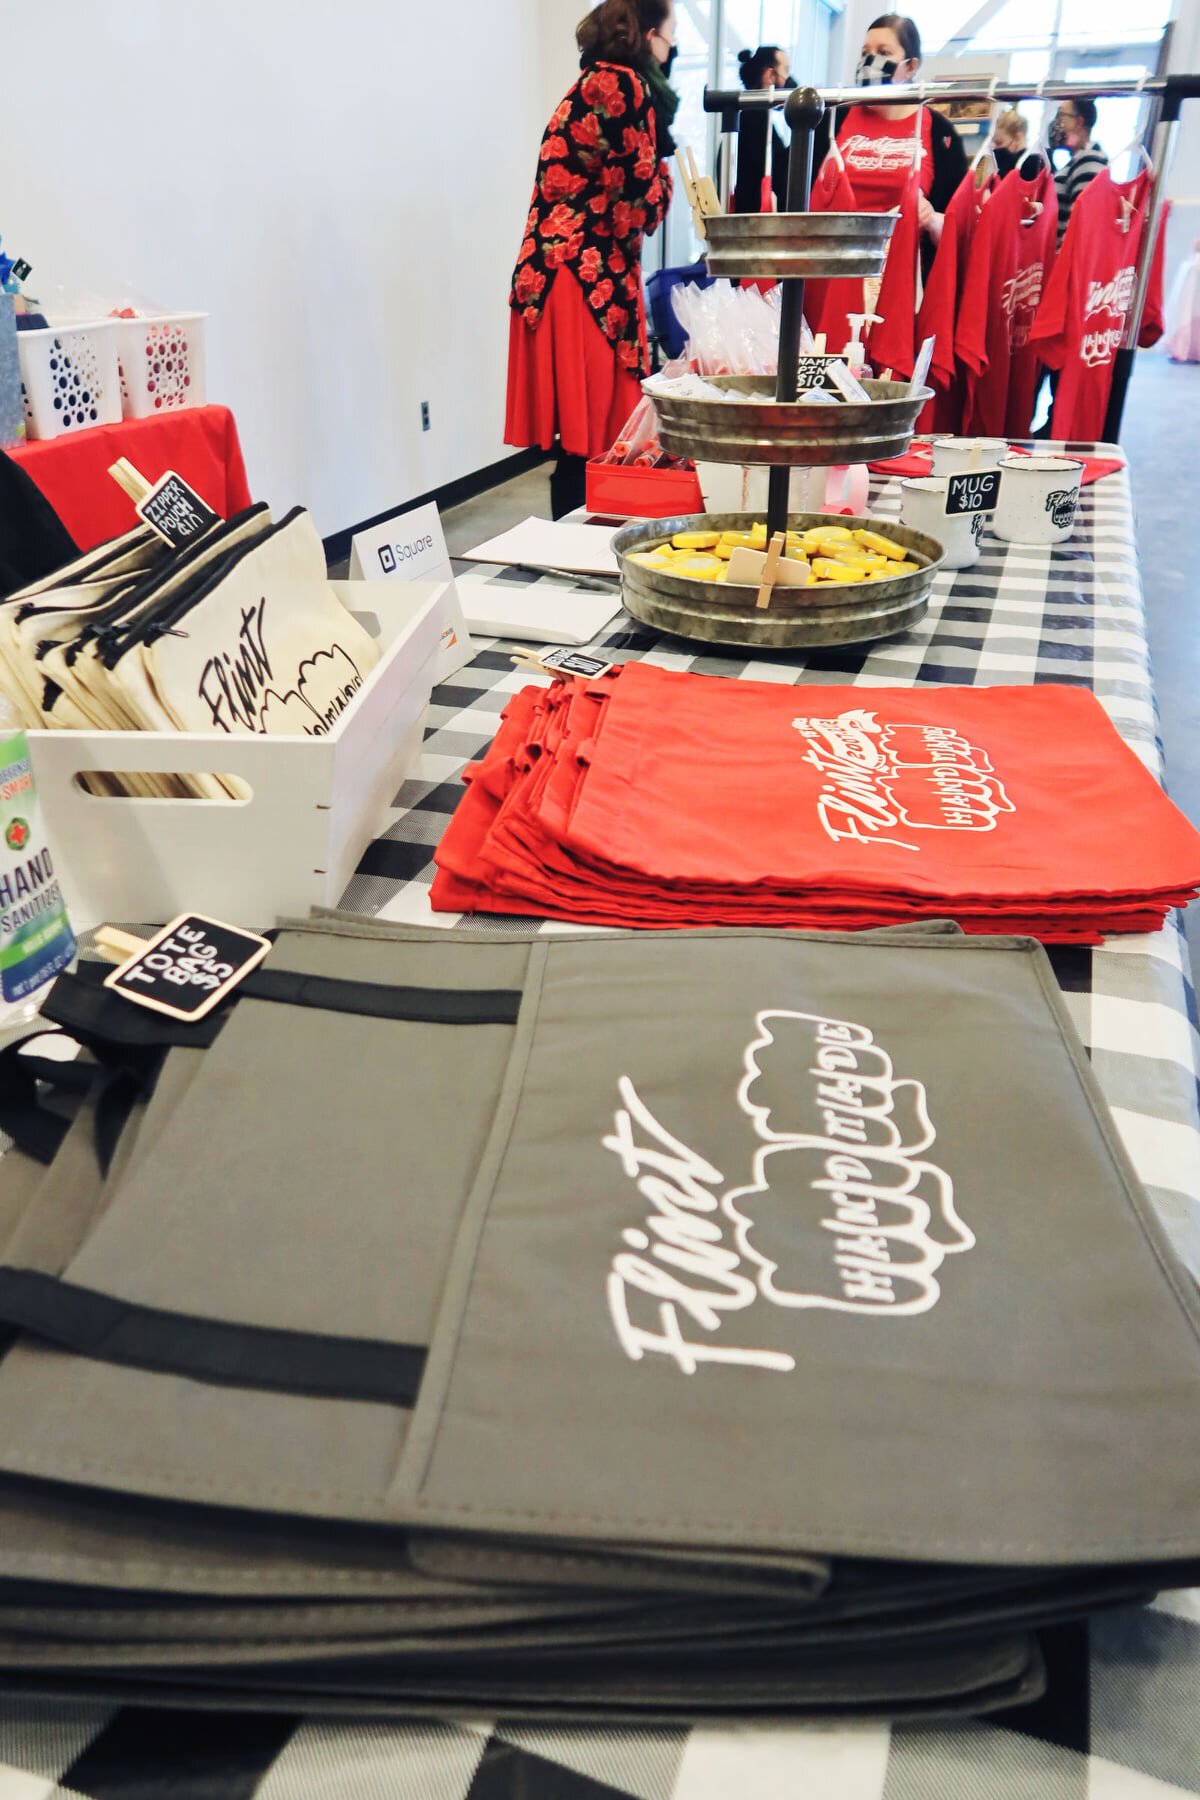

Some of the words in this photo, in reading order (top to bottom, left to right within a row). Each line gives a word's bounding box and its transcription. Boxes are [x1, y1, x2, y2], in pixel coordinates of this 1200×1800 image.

[797, 374, 825, 387] $10
[798, 365, 827, 375] PIN
[799, 357, 836, 367] NAME
[144, 480, 185, 522] ZIPPER
[952, 475, 995, 495] MUG
[958, 493, 983, 509] $10
[158, 496, 194, 535] POUCH
[395, 534, 433, 562] Square
[199, 596, 274, 733] Flint
[801, 738, 921, 851] Flint
[0, 847, 54, 907] HAND
[123, 925, 206, 984] TOTE
[162, 943, 218, 986] BAG
[190, 958, 234, 990] $5
[601, 1074, 797, 1376] Flint
